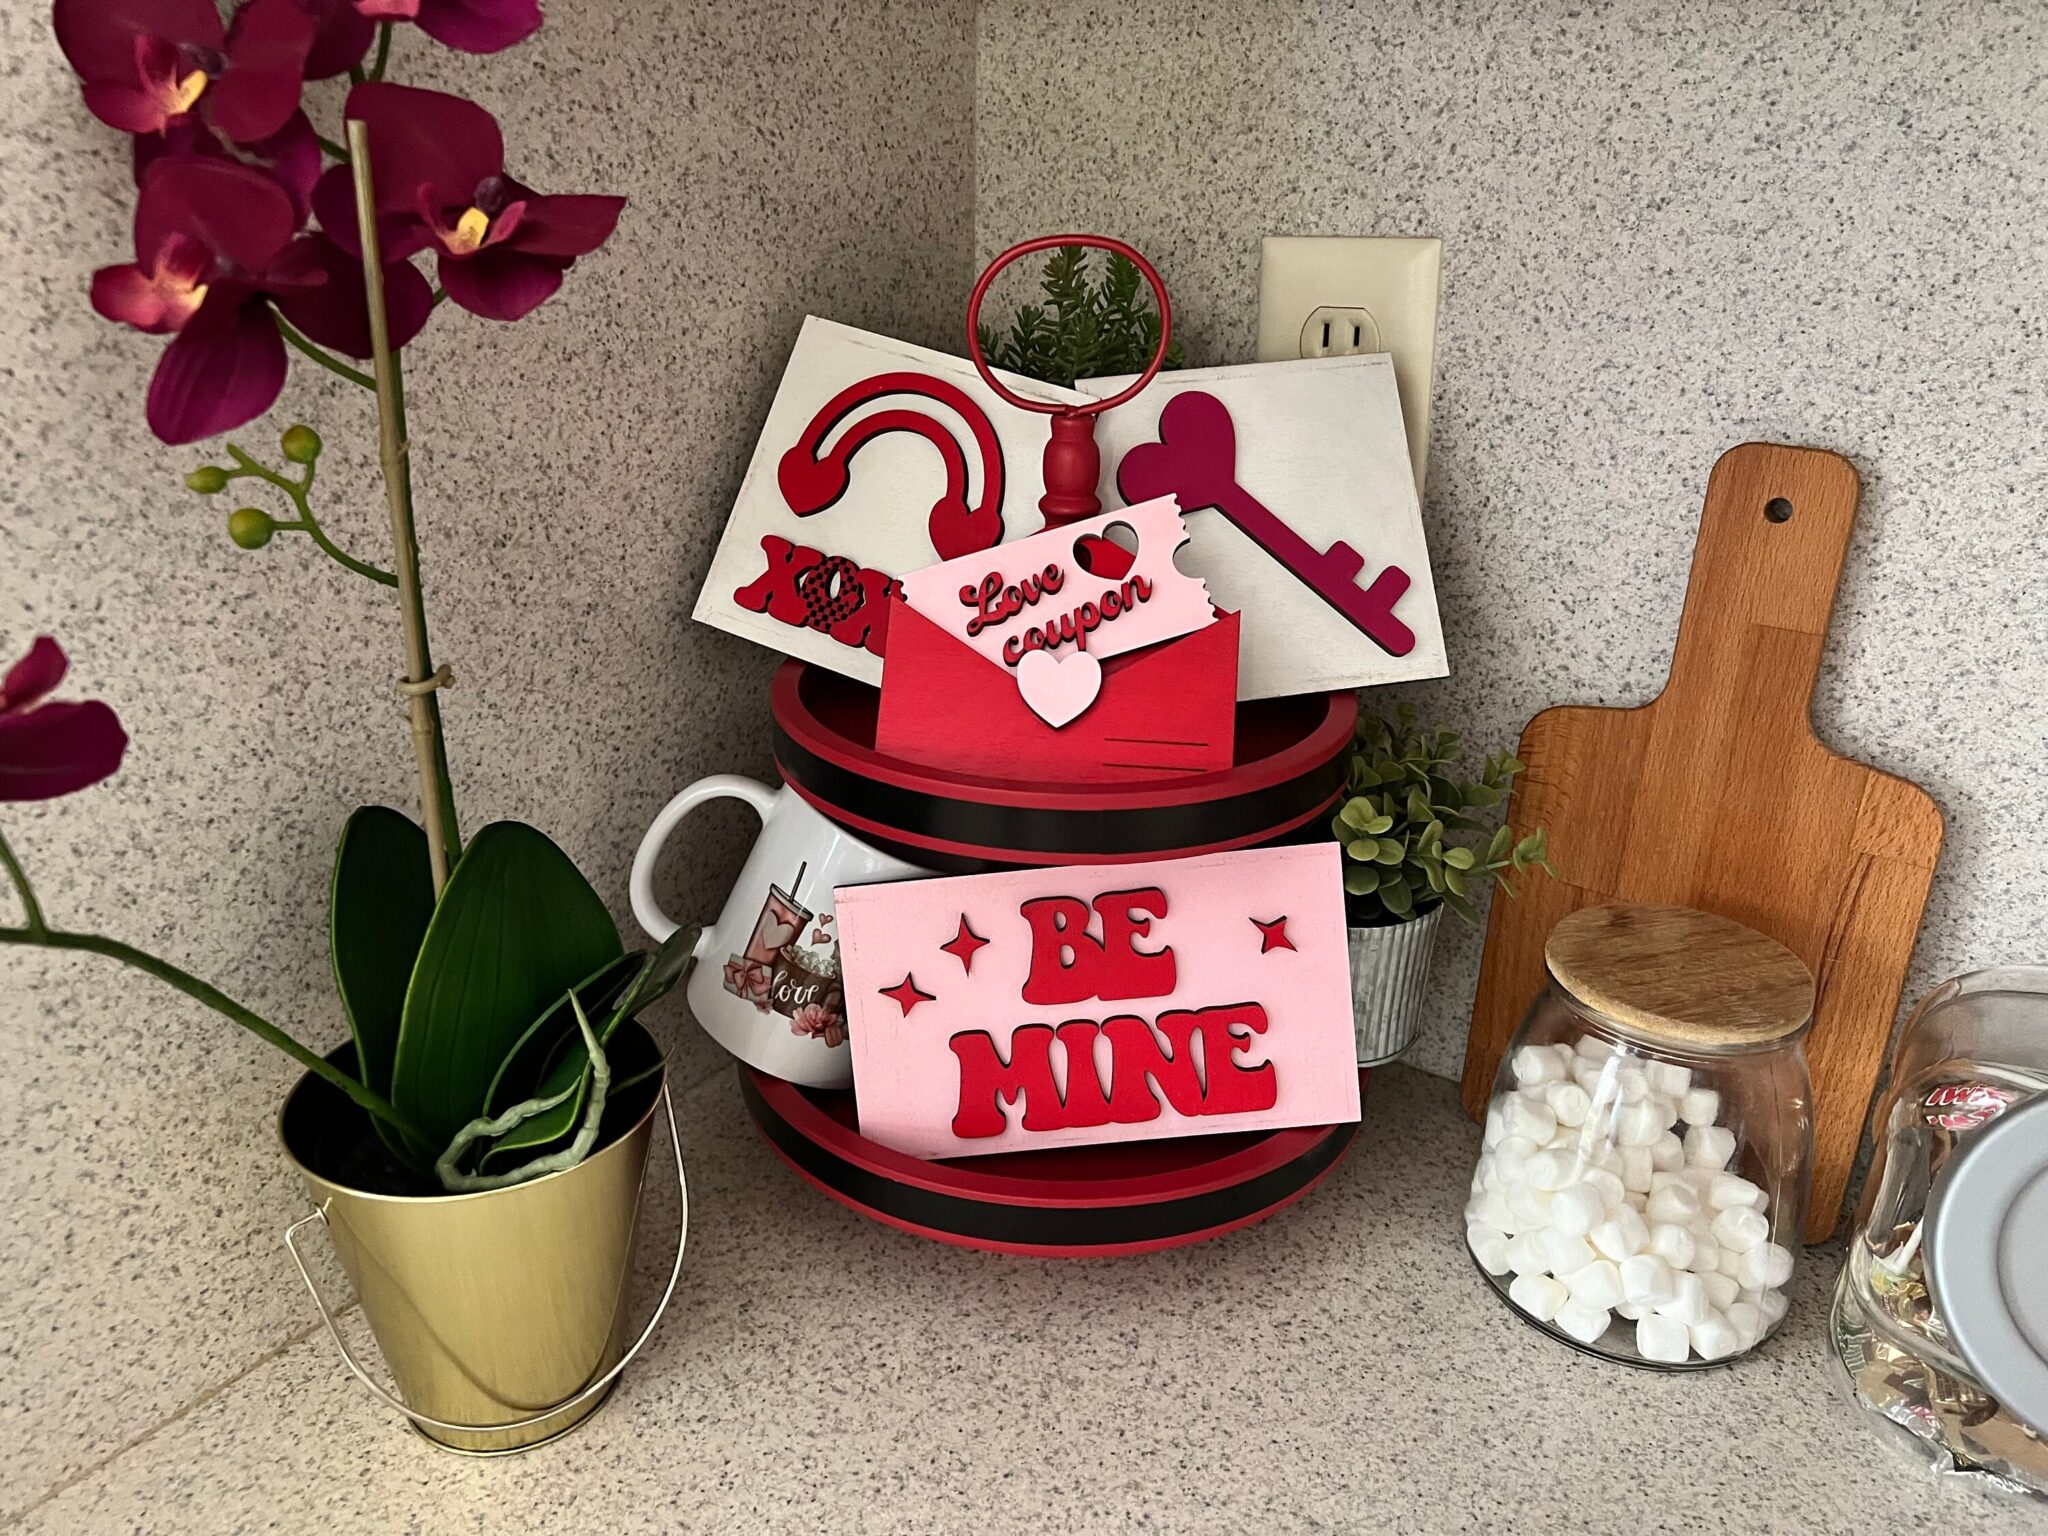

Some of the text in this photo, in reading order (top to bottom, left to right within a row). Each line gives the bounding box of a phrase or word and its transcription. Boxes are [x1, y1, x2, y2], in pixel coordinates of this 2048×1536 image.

[959, 563, 1065, 637] Love
[1002, 574, 1153, 667] coupon
[771, 970, 819, 1004] love
[1020, 887, 1177, 1005] BE
[949, 1001, 1278, 1139] MINE
